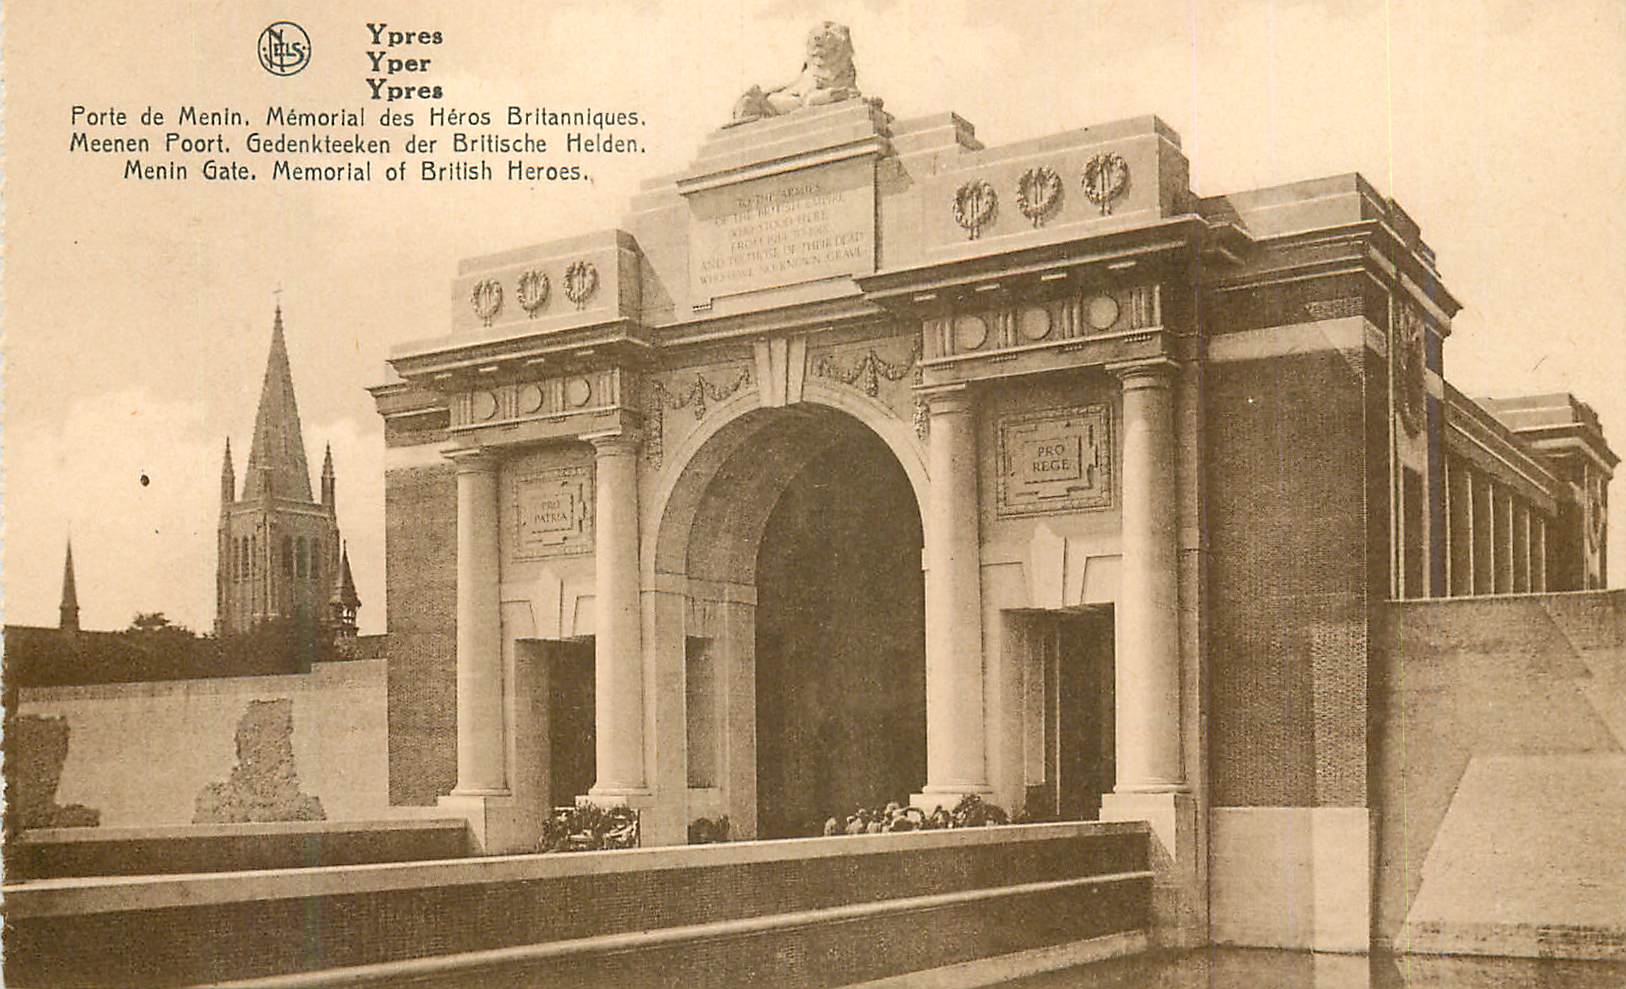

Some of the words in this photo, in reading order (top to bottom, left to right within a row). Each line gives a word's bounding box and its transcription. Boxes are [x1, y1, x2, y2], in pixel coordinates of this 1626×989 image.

[1038, 444, 1065, 457] PRO
[1033, 459, 1070, 472] REGE
[534, 513, 568, 524] PATRIA
